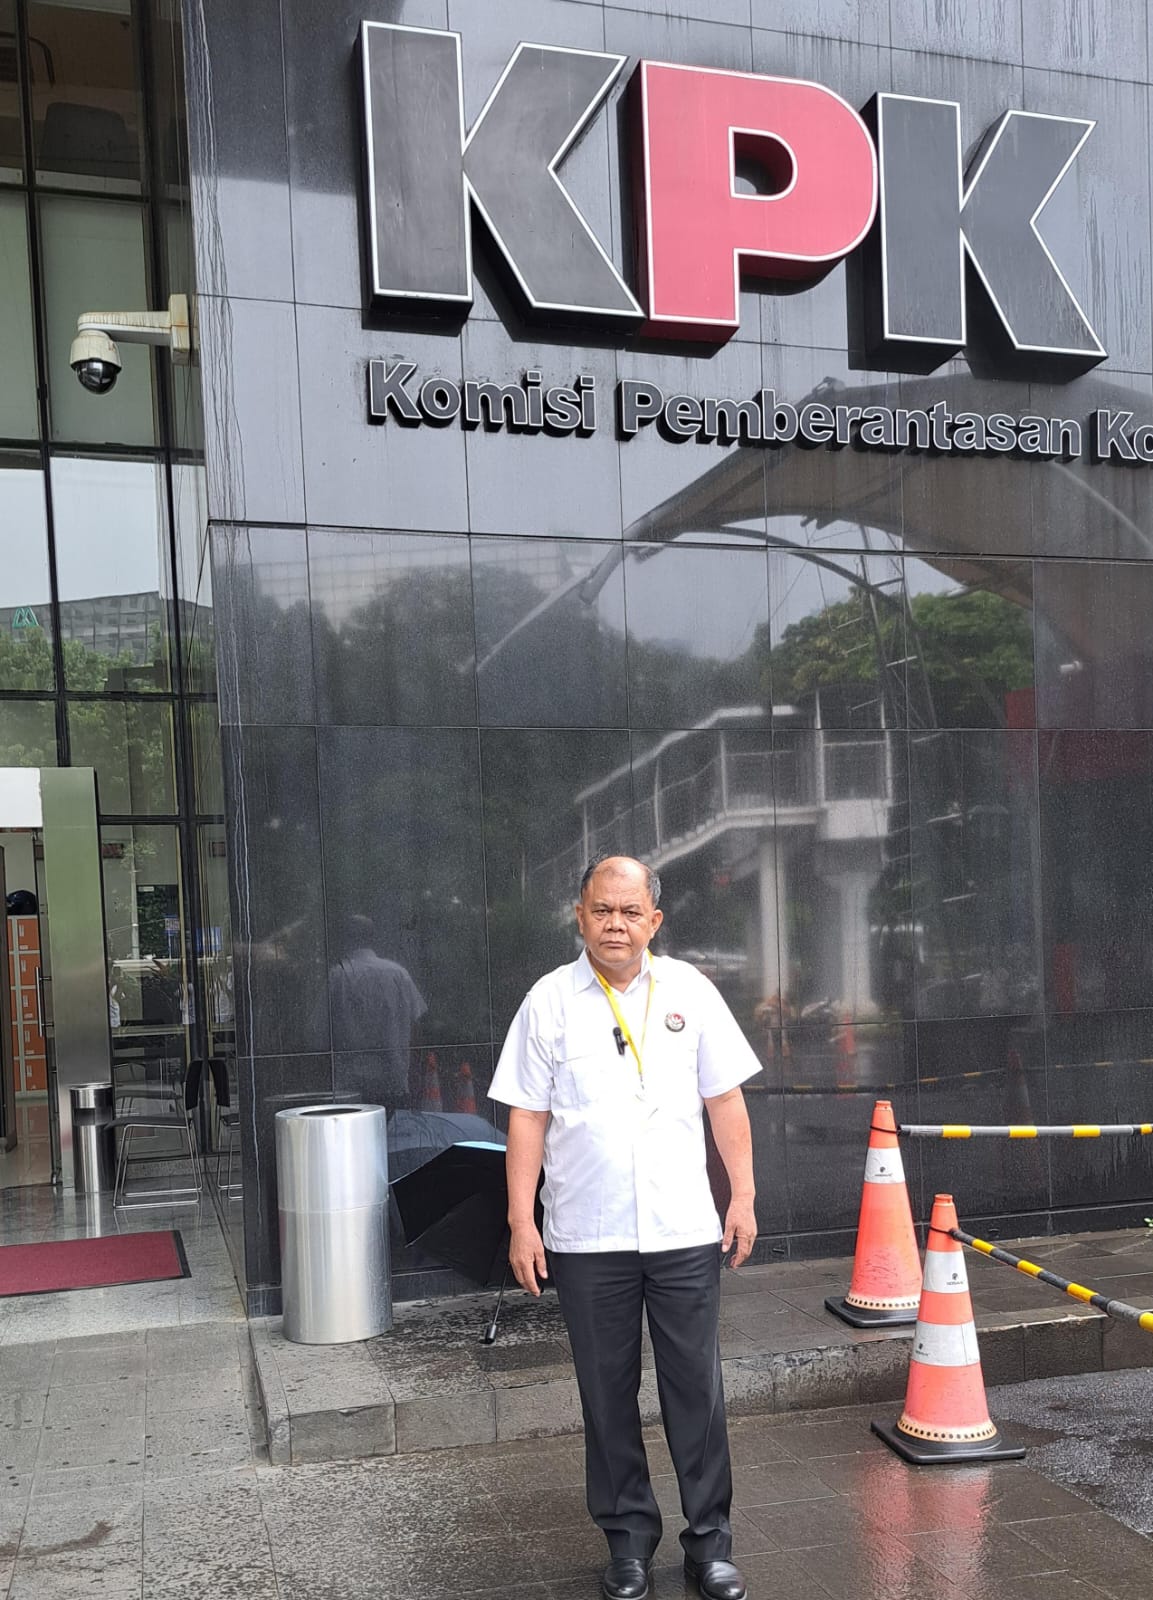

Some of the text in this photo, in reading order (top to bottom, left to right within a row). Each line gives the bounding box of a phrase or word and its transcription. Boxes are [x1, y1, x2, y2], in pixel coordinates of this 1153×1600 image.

[361, 20, 1108, 359] KPK
[369, 359, 597, 430] Komisi
[621, 379, 1082, 457] Pemberantasan
